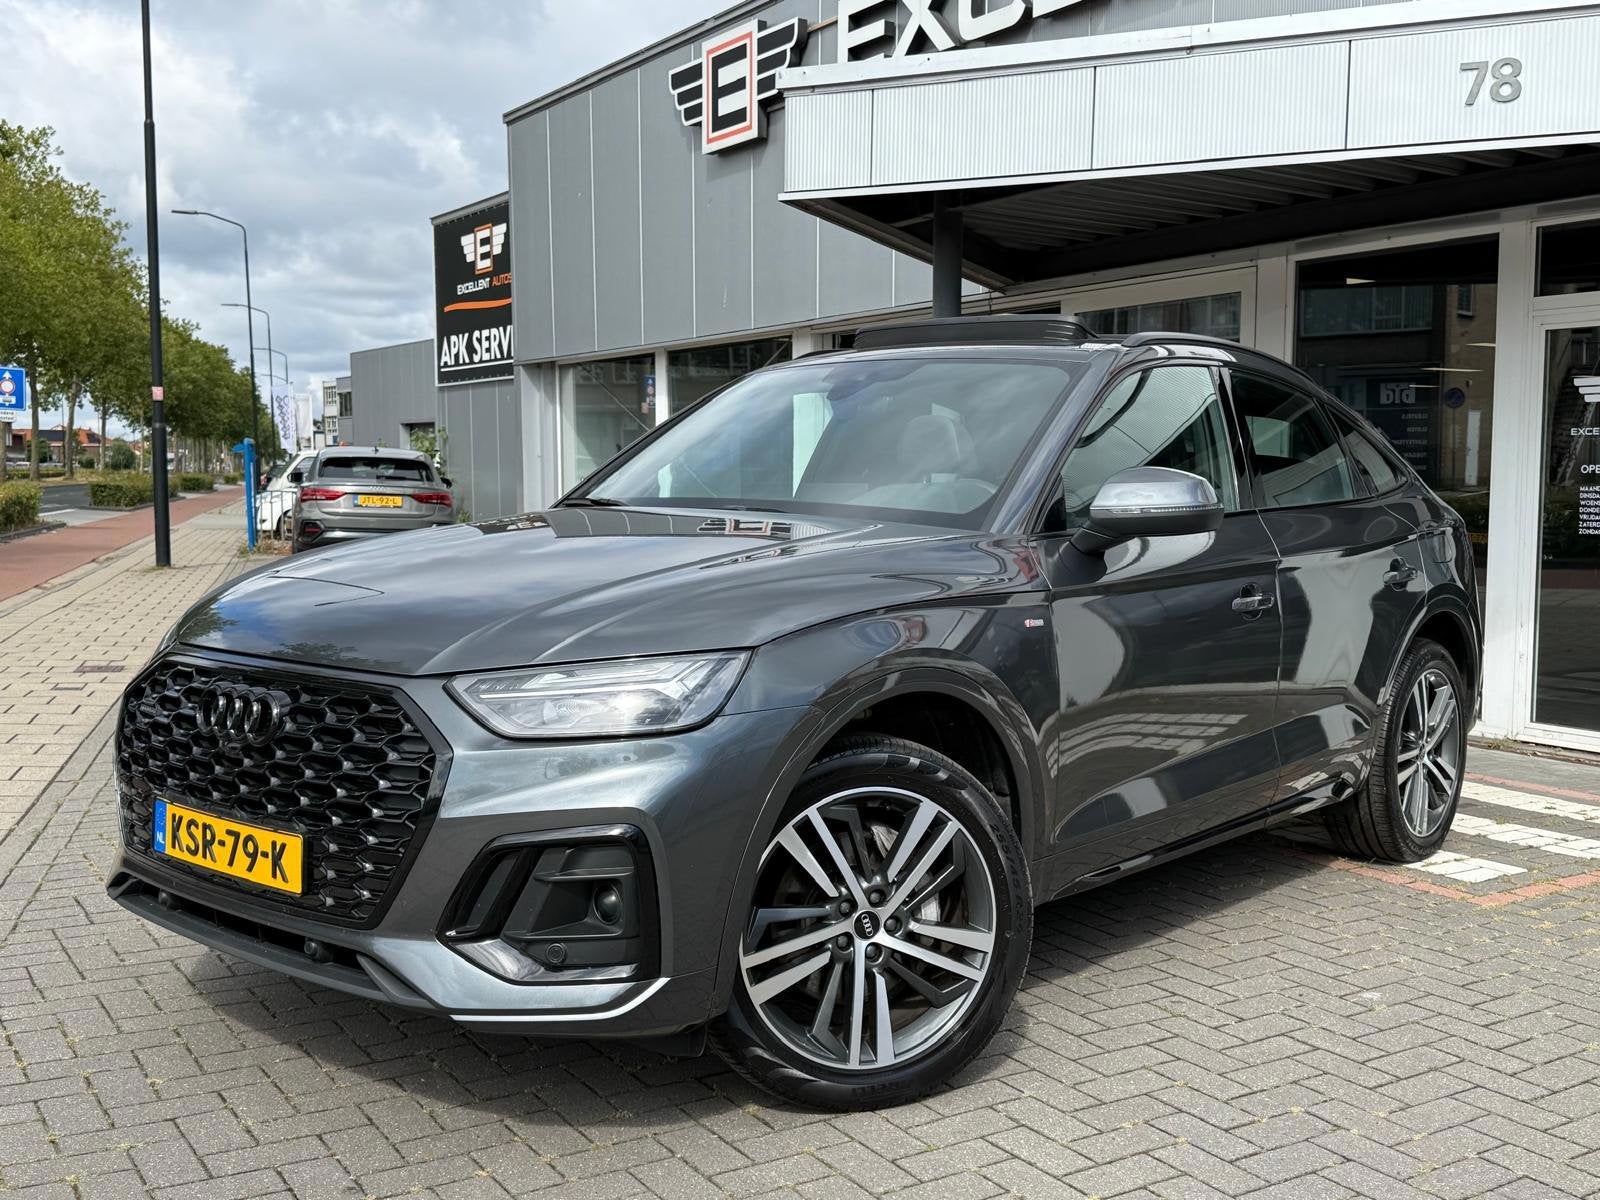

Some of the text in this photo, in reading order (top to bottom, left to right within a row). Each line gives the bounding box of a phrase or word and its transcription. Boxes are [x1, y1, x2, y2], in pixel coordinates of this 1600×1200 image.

[837, 0, 1088, 62] EXC
[1460, 57, 1522, 105] 78
[457, 272, 512, 295] EXCELLENT AUTOS
[440, 332, 469, 366] APK
[1570, 427, 1600, 436] EXCE
[362, 496, 397, 504] JTL-92-L
[156, 831, 165, 844] NL
[170, 812, 289, 884] KSR-79-K
